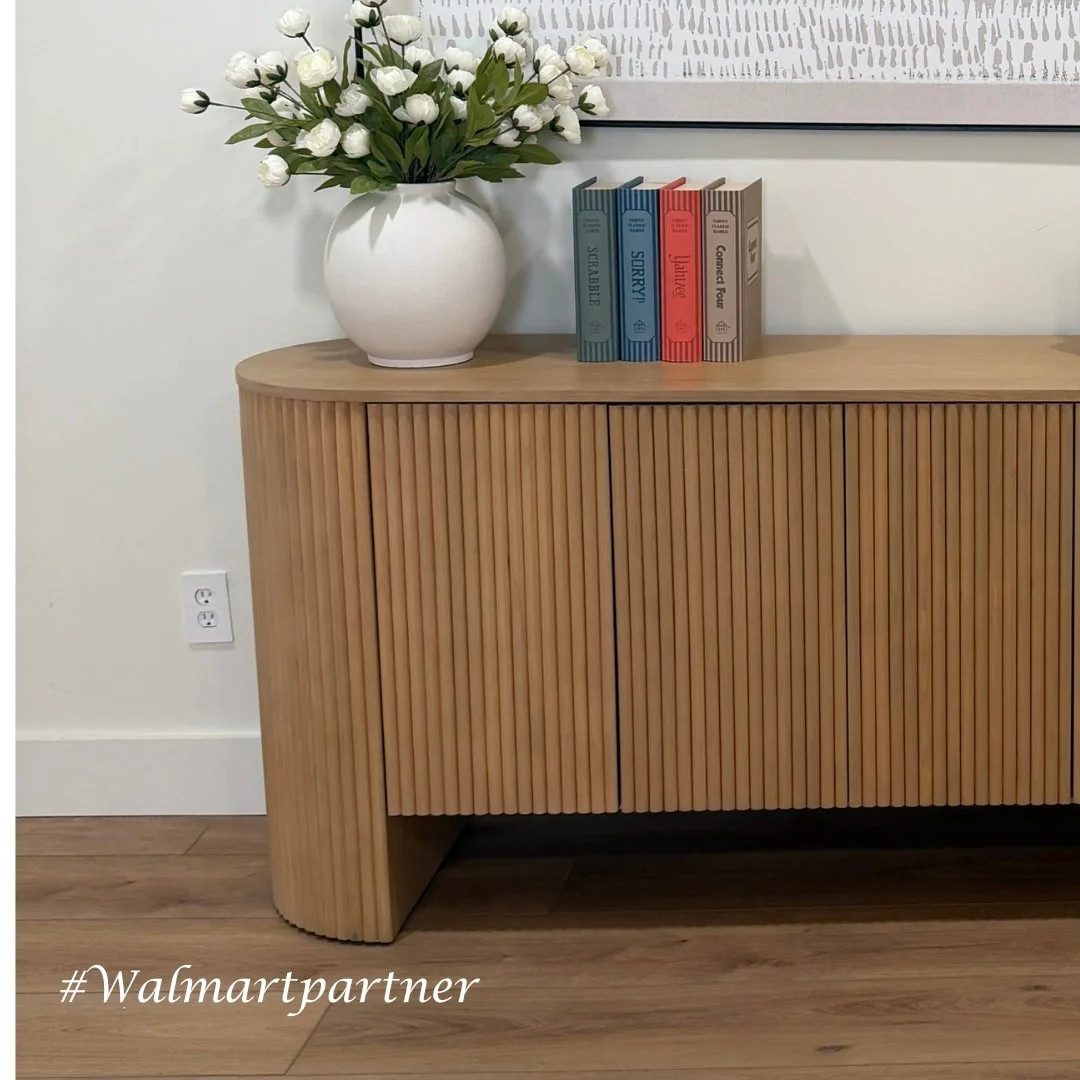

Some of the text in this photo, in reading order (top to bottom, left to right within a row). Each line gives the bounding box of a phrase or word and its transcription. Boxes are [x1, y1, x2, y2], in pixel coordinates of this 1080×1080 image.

[587, 246, 601, 307] SCRABBLE
[668, 254, 693, 299] Yahtzee
[715, 244, 726, 310] Connect Four
